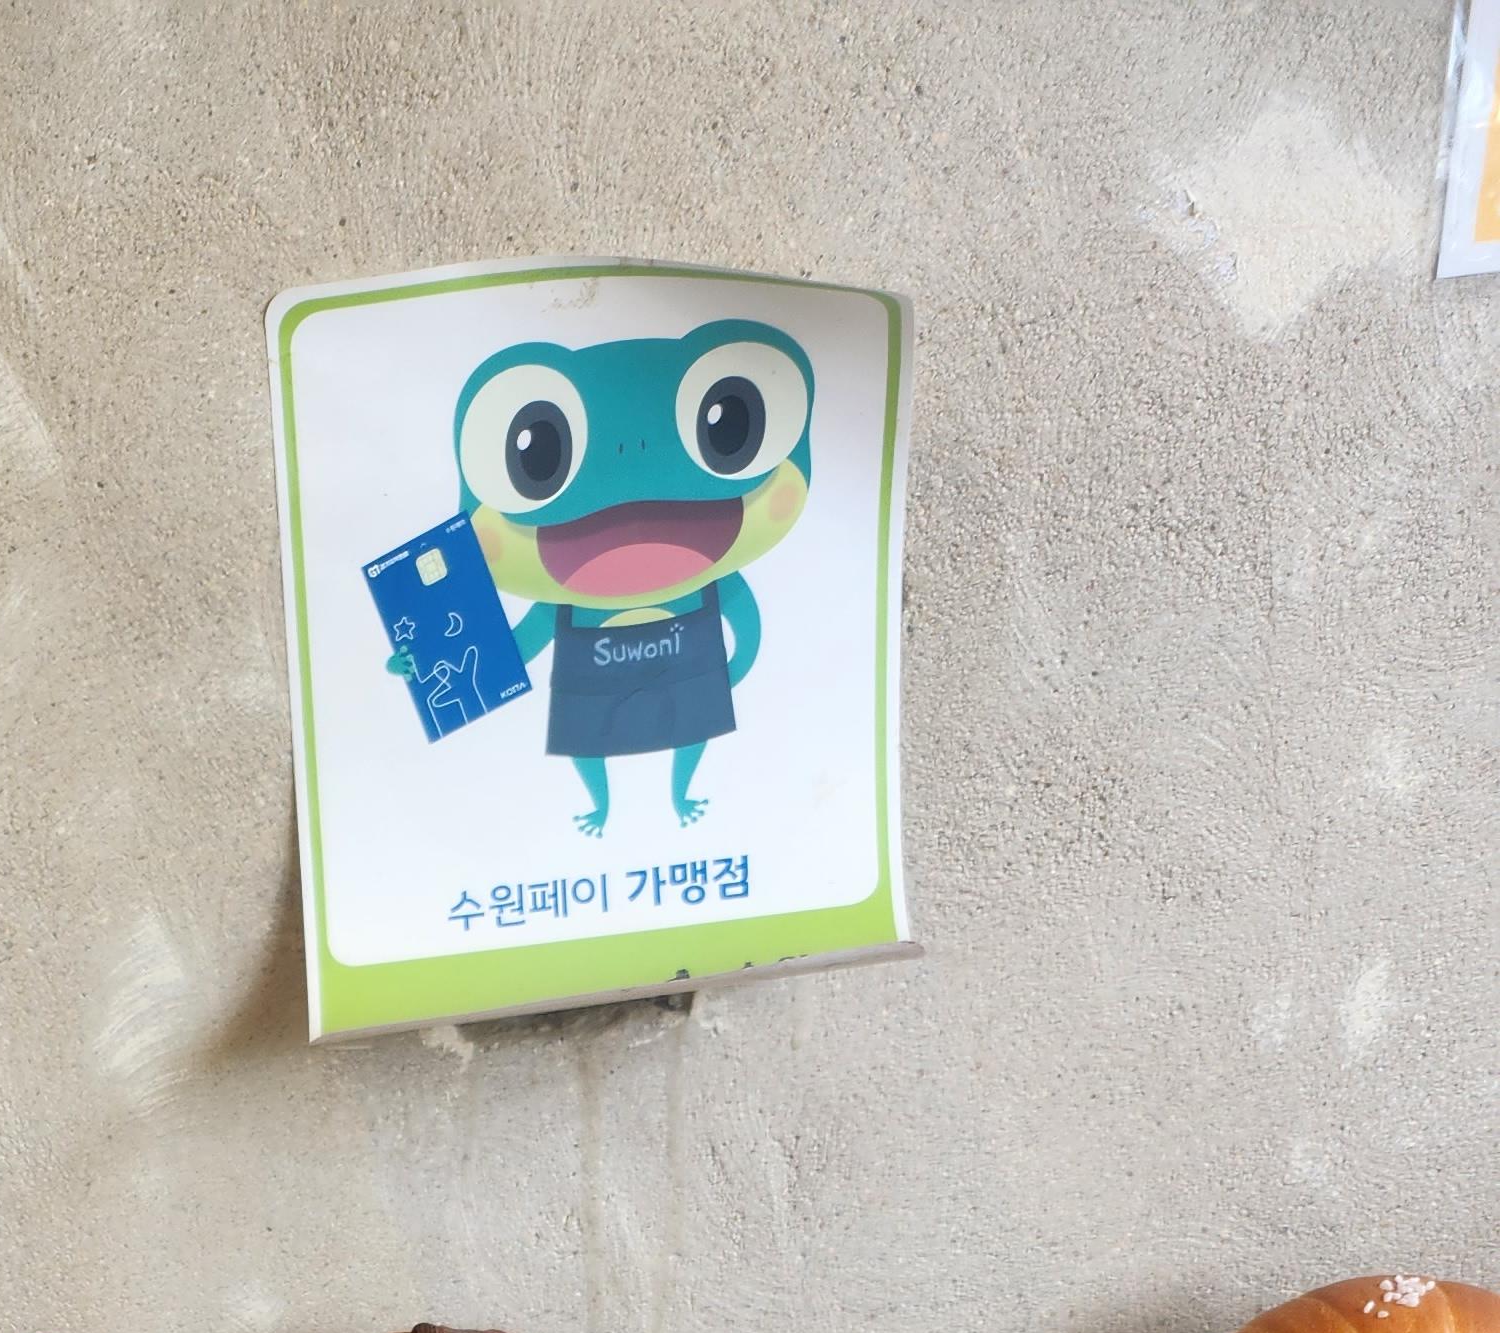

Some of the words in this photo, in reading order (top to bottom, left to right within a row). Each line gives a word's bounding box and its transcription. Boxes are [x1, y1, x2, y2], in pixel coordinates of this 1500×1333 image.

[594, 623, 684, 666] Suwoni
[448, 873, 609, 931] 수원페이
[625, 854, 749, 906] 가맹점
